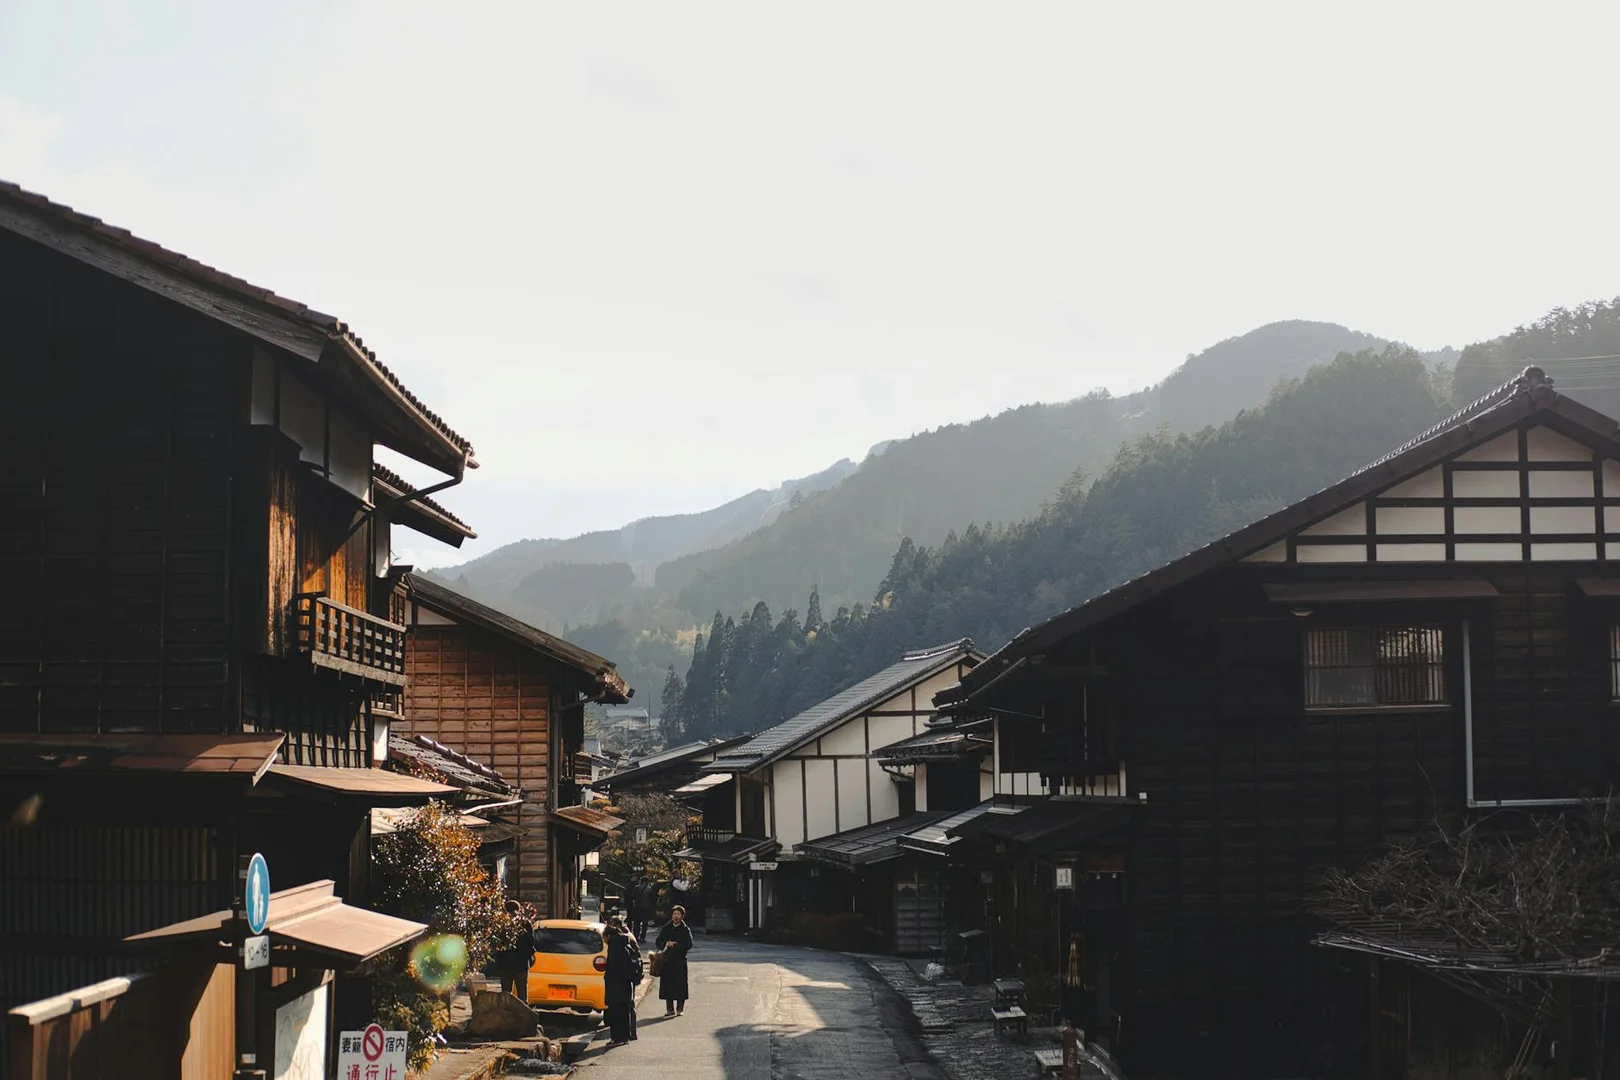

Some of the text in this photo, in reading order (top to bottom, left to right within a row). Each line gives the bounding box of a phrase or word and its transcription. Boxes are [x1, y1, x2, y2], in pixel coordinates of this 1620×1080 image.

[385, 1037, 405, 1052] 宿内
[346, 1063, 397, 1080] 通行止
